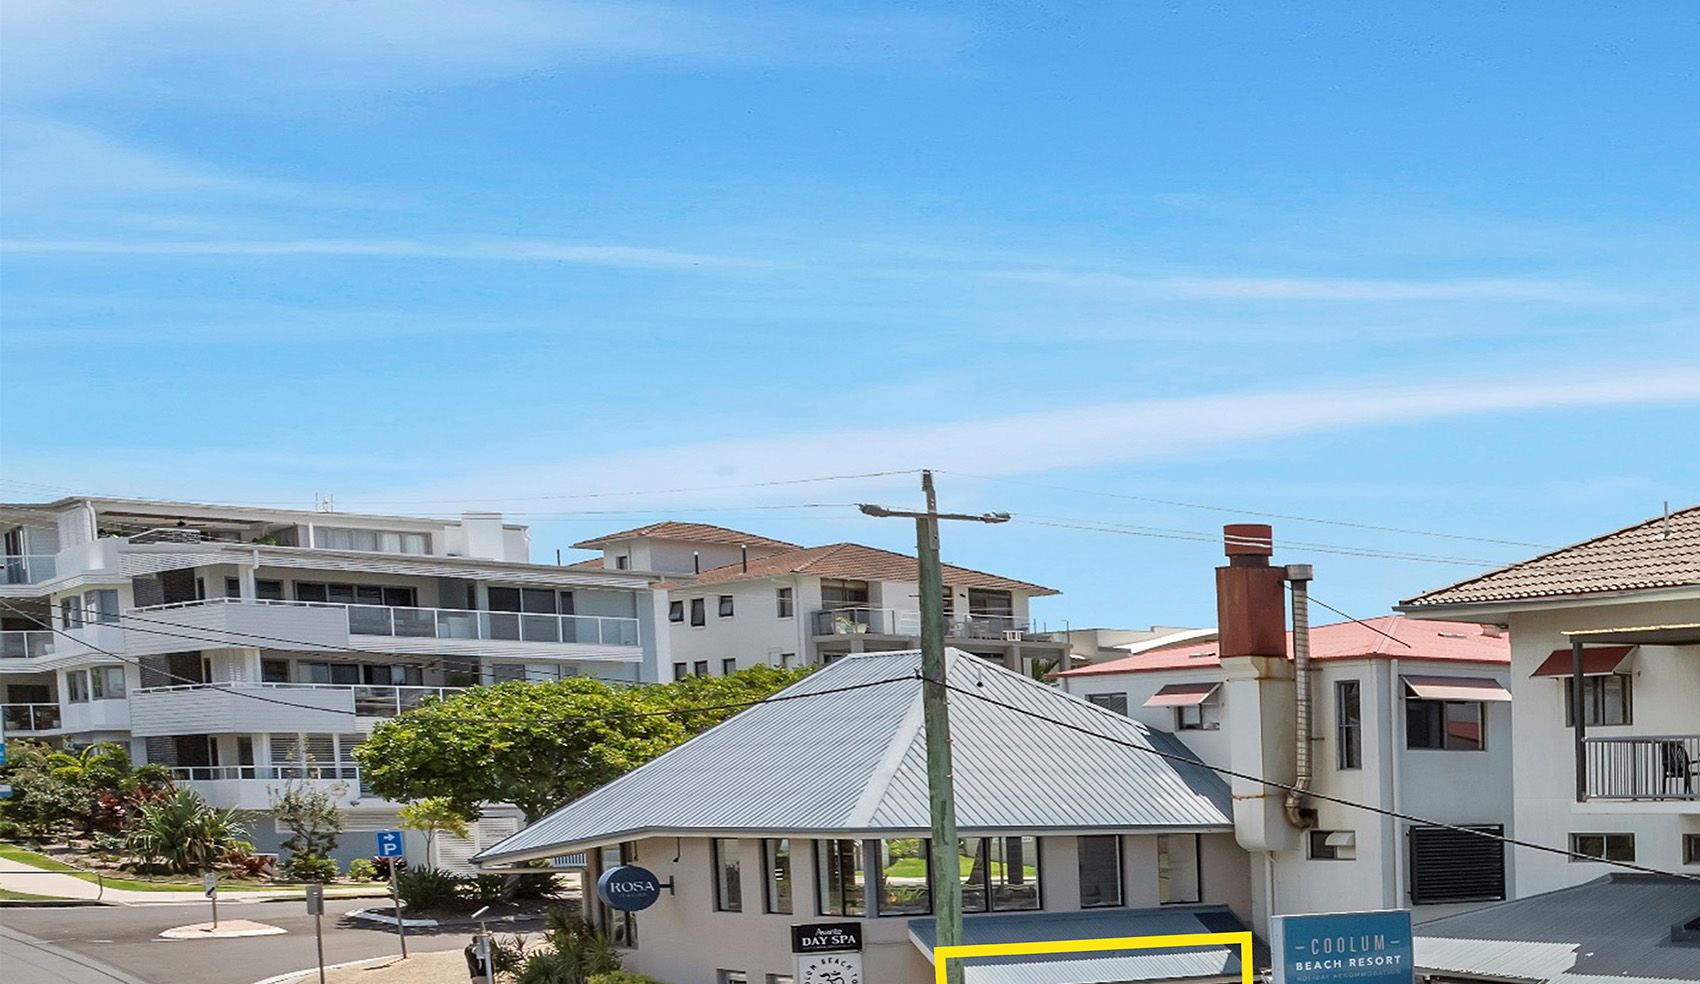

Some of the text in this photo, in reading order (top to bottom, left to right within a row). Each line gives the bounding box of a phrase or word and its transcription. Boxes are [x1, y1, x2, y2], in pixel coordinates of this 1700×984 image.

[384, 843, 397, 856] P
[610, 881, 655, 893] ROSA
[801, 934, 857, 947] DAY SPA
[1311, 934, 1385, 955] COOLUM
[1295, 955, 1401, 971] BEACH RESORT
